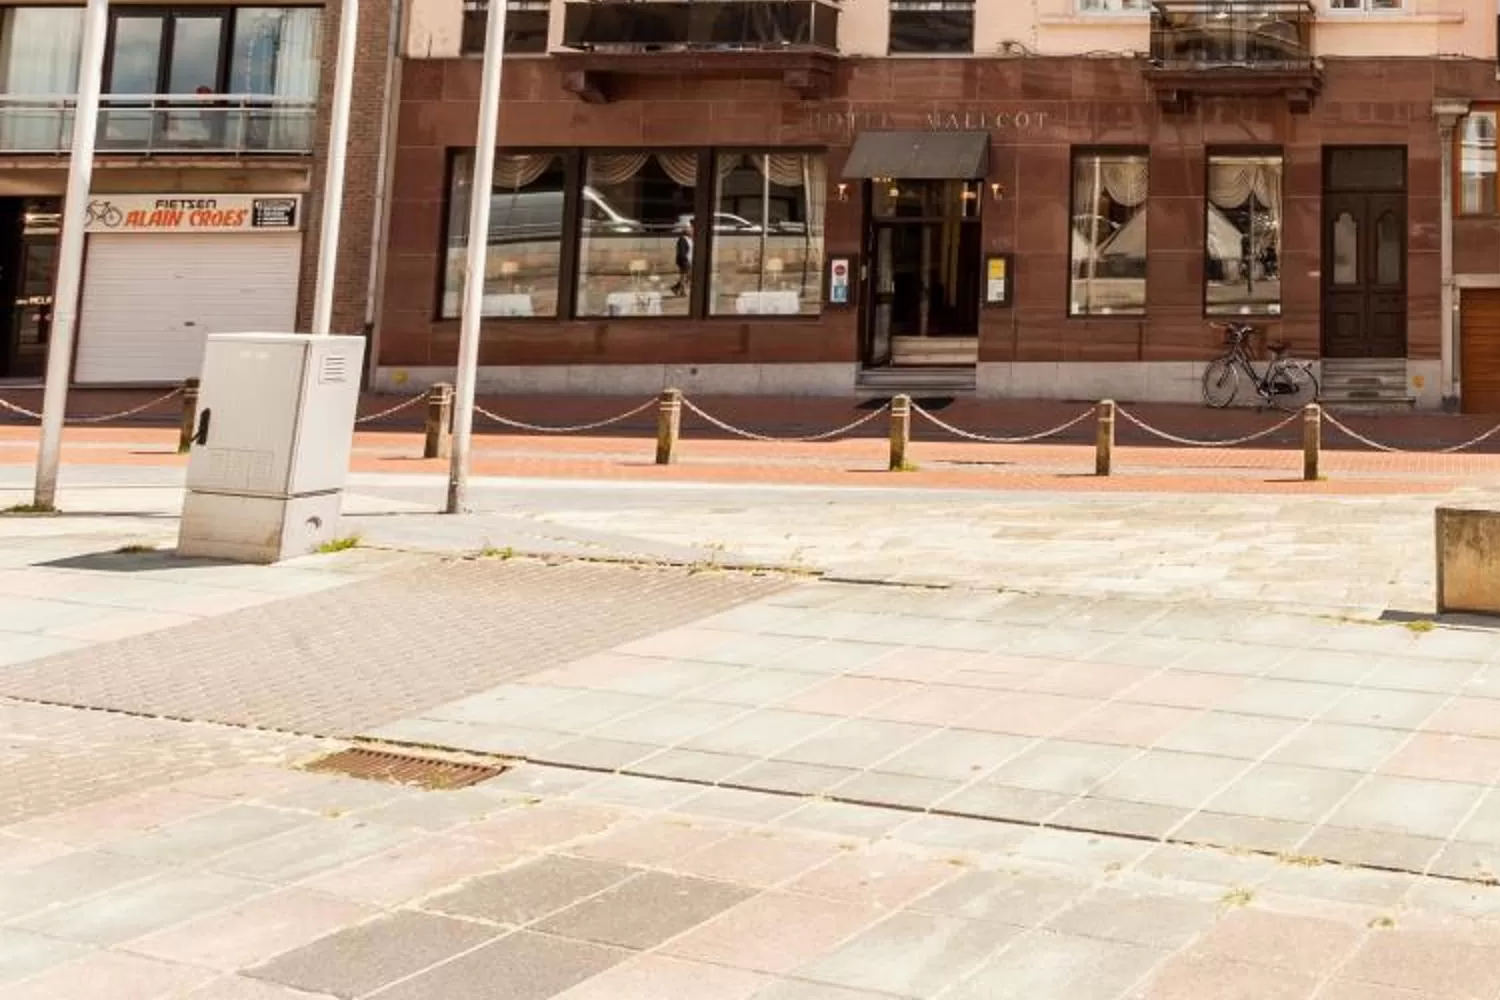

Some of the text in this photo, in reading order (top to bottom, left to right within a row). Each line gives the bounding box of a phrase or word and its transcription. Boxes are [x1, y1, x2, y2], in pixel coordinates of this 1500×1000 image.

[155, 199, 217, 209] FIETSEN
[125, 209, 185, 227] ALAIN
[189, 209, 249, 227] CROES
